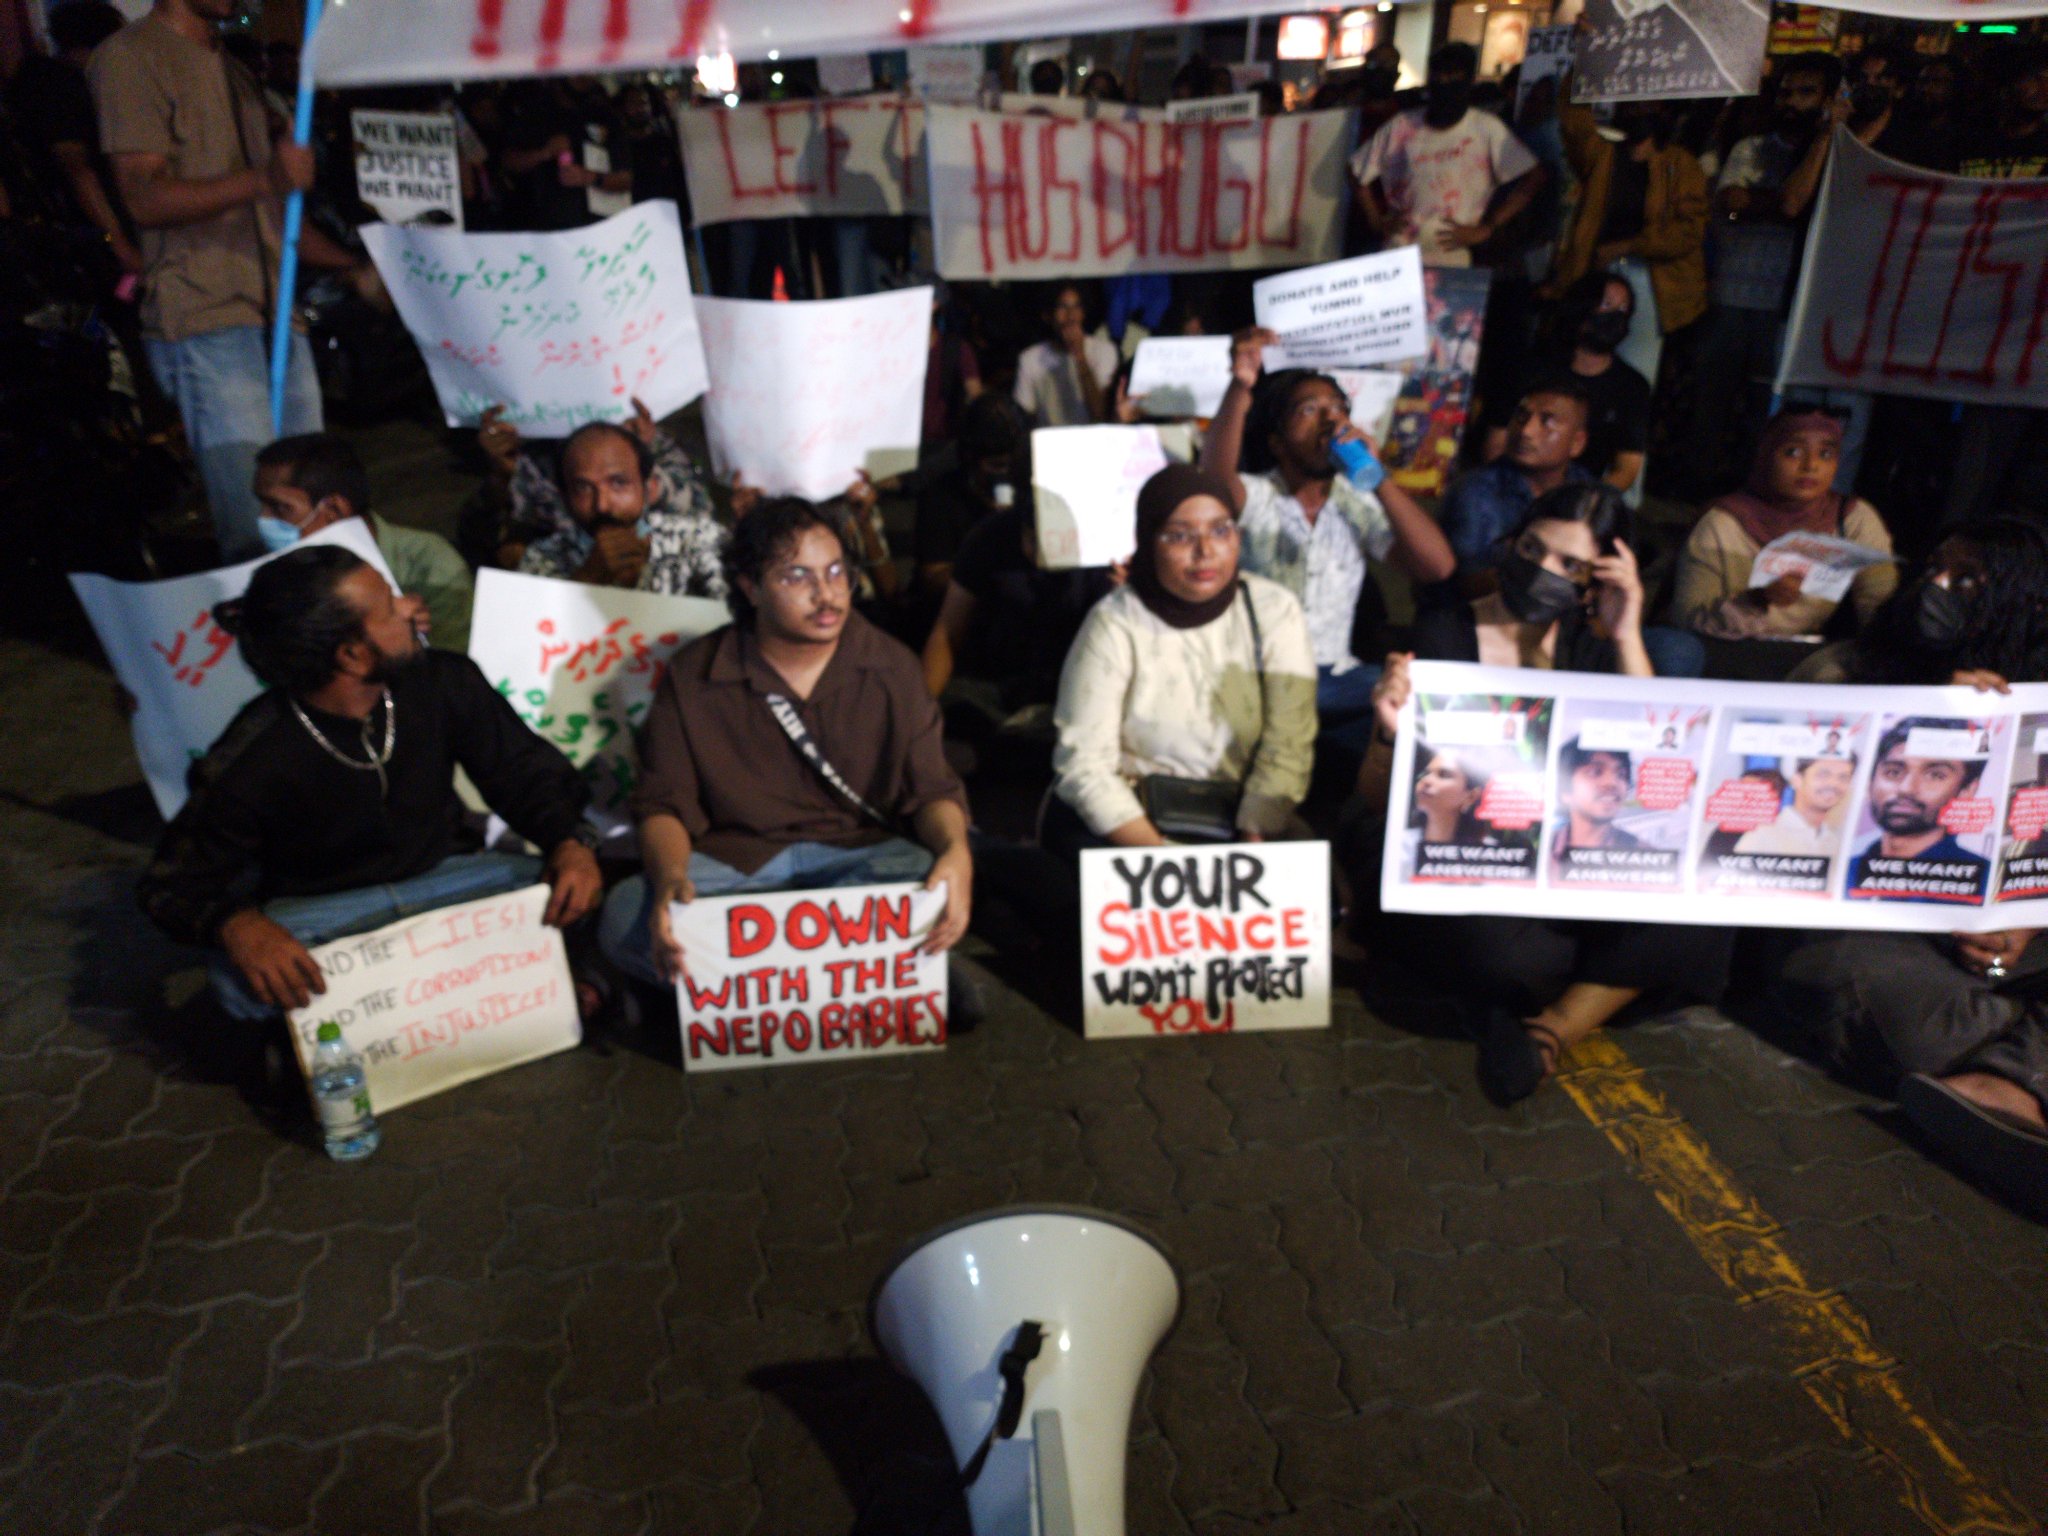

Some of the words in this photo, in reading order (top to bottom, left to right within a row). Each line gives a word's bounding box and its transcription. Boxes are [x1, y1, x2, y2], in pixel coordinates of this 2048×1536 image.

[360, 121, 390, 142] WE
[394, 122, 454, 143] WANT
[363, 148, 452, 179] JUSTICE
[713, 102, 924, 201] LEFT
[362, 179, 391, 198] WE
[396, 180, 454, 201] WANT
[970, 116, 1080, 273] HUS
[1424, 845, 1459, 861] WE
[1463, 847, 1527, 862] WANT
[1570, 850, 1606, 866] WE
[1609, 851, 1673, 867] WANT
[1718, 855, 1752, 870] WE
[1755, 857, 1823, 872] WANT
[1868, 859, 1904, 873] WE
[1907, 861, 1979, 878] WANT
[2009, 859, 2032, 874] WE
[1112, 851, 1271, 914] YOUR
[1418, 863, 1529, 879] ANSWERS!
[1564, 867, 1676, 884] ANSWERS!
[1860, 877, 1979, 894] ANSWERS!
[320, 950, 355, 978] ND
[352, 935, 396, 968] THE
[403, 904, 526, 960] LIES!
[727, 895, 912, 959] DOWN
[685, 966, 810, 1012] WITH
[823, 949, 920, 998] THE
[301, 1007, 356, 1045] ED
[354, 986, 398, 1018] THE
[362, 1036, 401, 1066] THE
[400, 976, 559, 1063] INJUSTICE!
[688, 1010, 813, 1059] NEPO
[820, 991, 947, 1052] BABIES
[1139, 996, 1234, 1035] YOU
